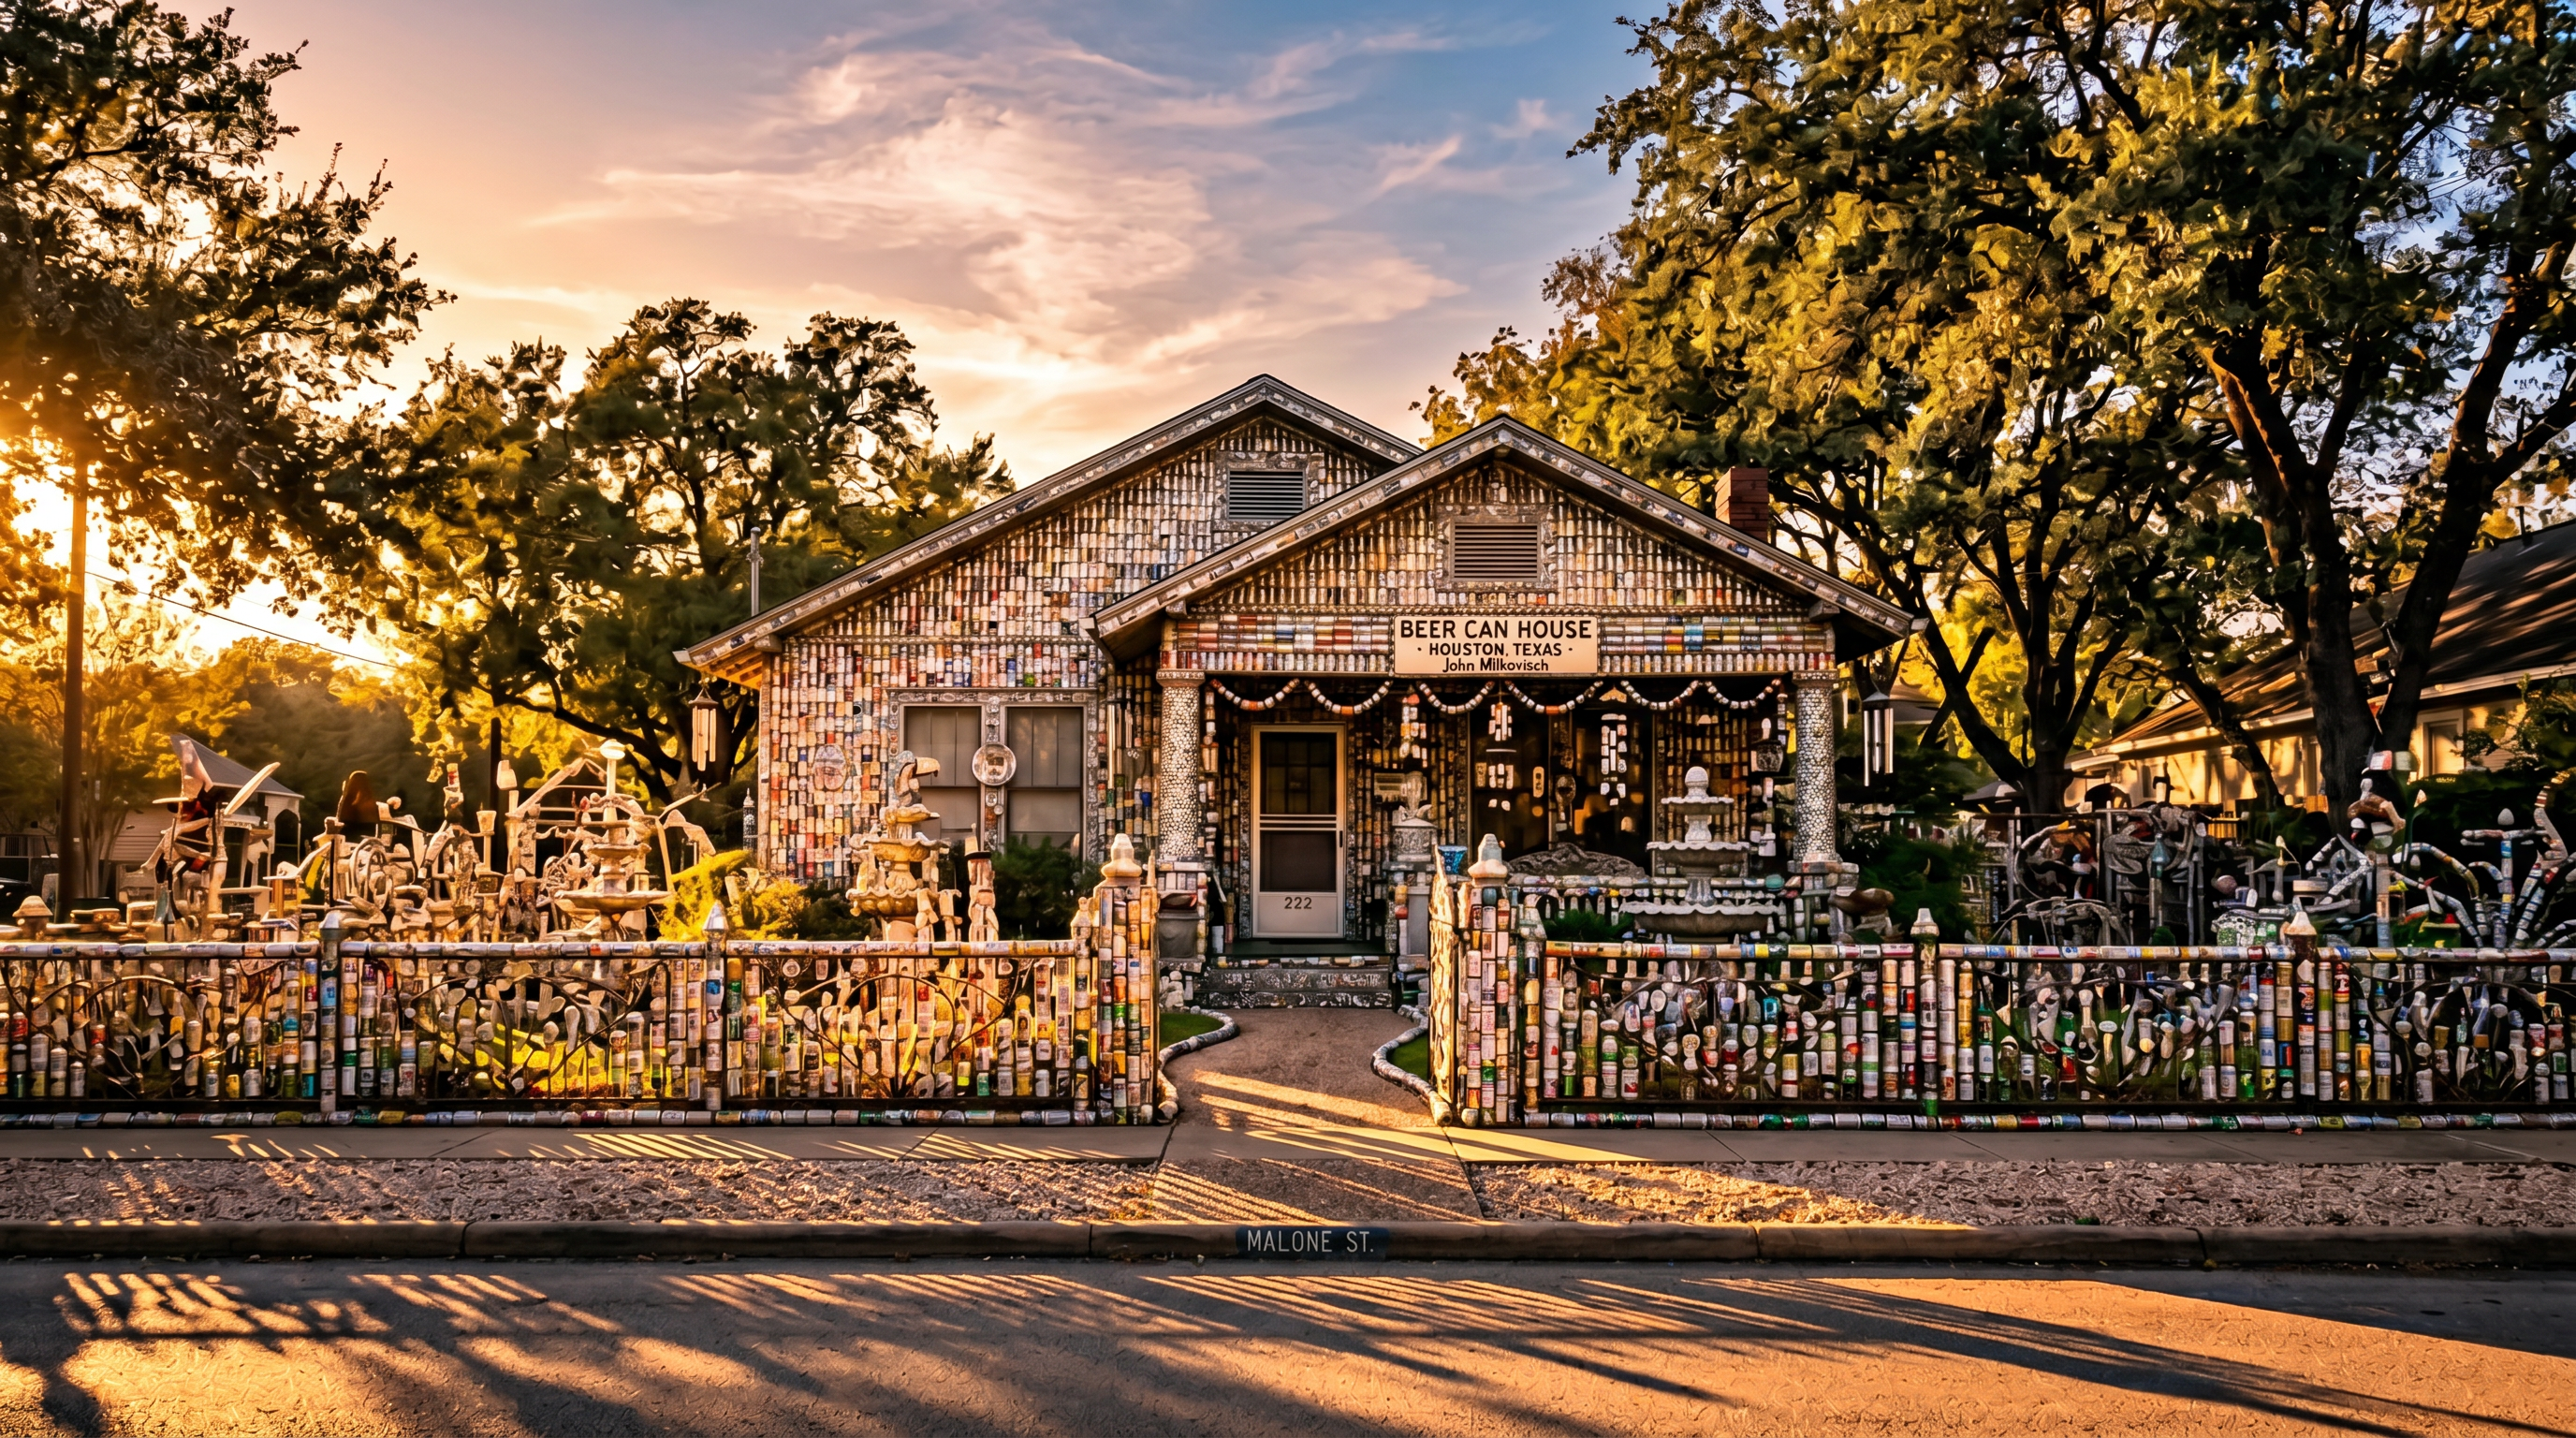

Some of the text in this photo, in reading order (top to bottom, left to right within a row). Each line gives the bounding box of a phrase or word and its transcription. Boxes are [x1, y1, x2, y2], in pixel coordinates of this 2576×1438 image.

[1400, 620, 1592, 638] BEER CAN HOUSE
[1429, 643, 1562, 657] HOUSTON, TEXAS
[1442, 657, 1549, 672] John Milkovisch
[1284, 897, 1312, 909] 222
[1247, 1230, 1374, 1253] MALONE ST.
